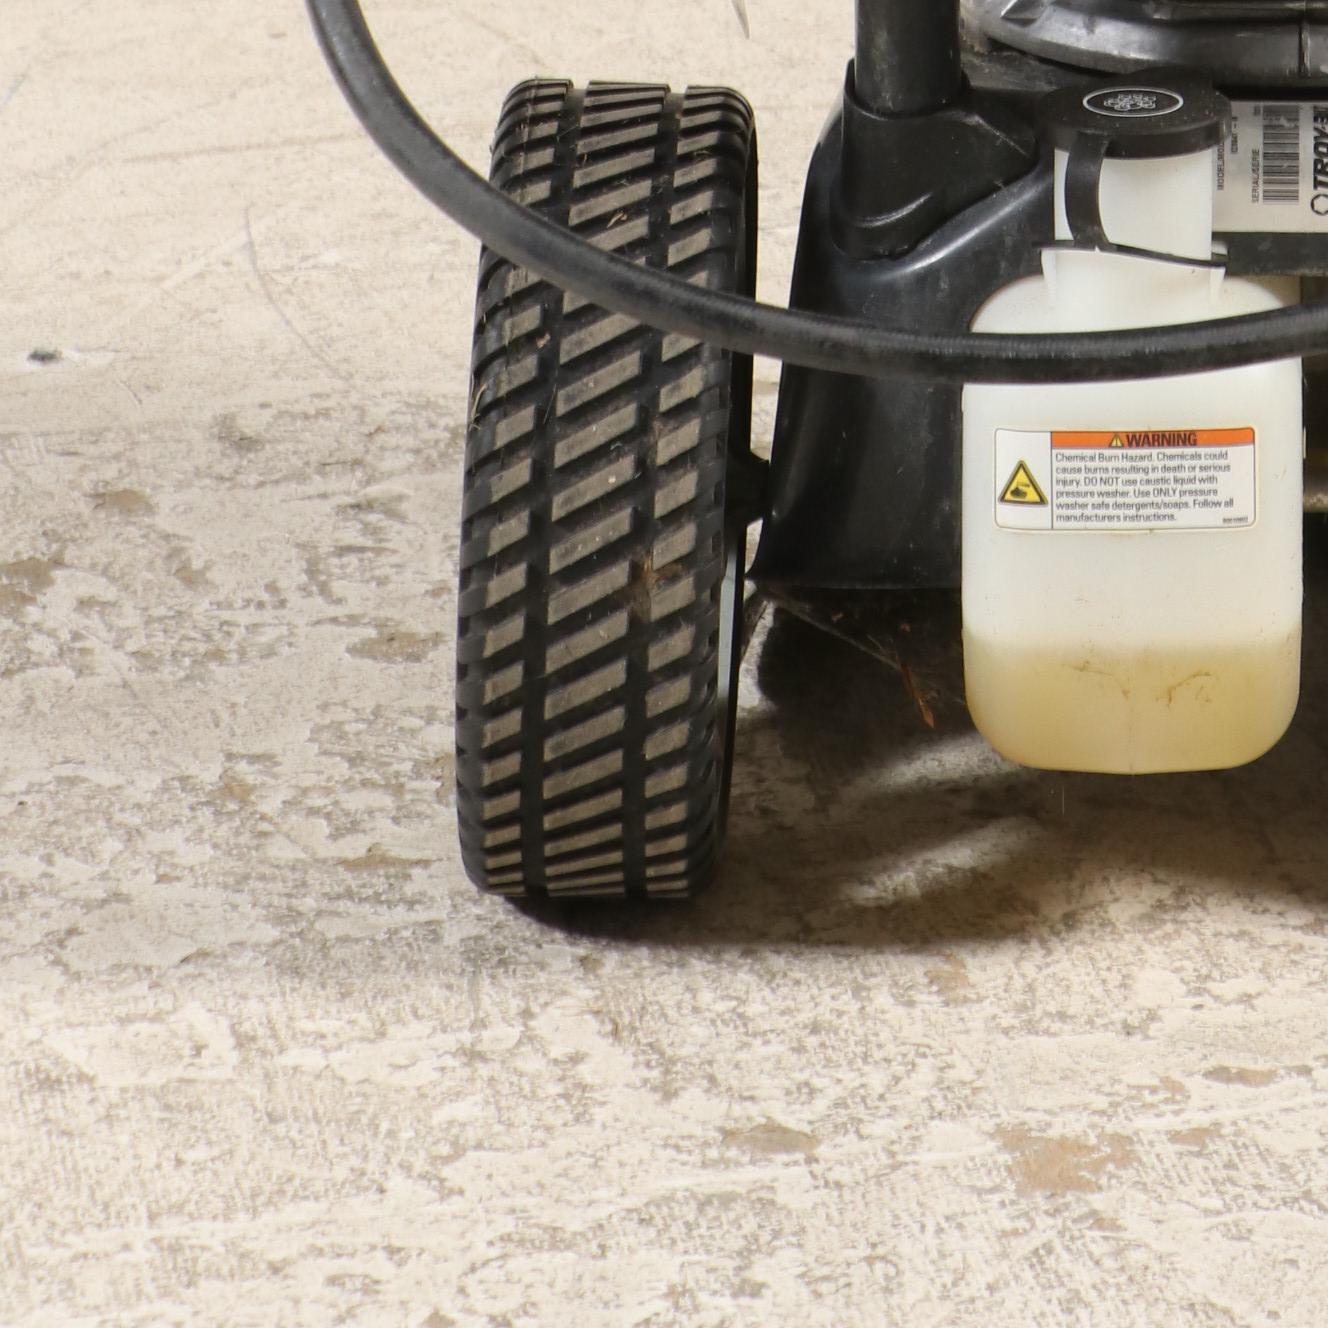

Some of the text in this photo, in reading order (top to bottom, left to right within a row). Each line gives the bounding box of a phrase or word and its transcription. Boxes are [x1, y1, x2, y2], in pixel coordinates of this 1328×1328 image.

[1126, 432, 1197, 448] WARNING
[1055, 450, 1229, 462] Chemical Burn Hazard. Chemicals could
[1055, 463, 1231, 477] cause burns resulting in death or serious
[1055, 474, 1218, 489] injury. DO NOT use caustic liquid with
[1055, 487, 1218, 501] pressure washer. Use ONLY pressure
[1055, 498, 1234, 513] washer safe detergents/soaps. Follow all
[1055, 512, 1177, 523] manufacturers instructions.
